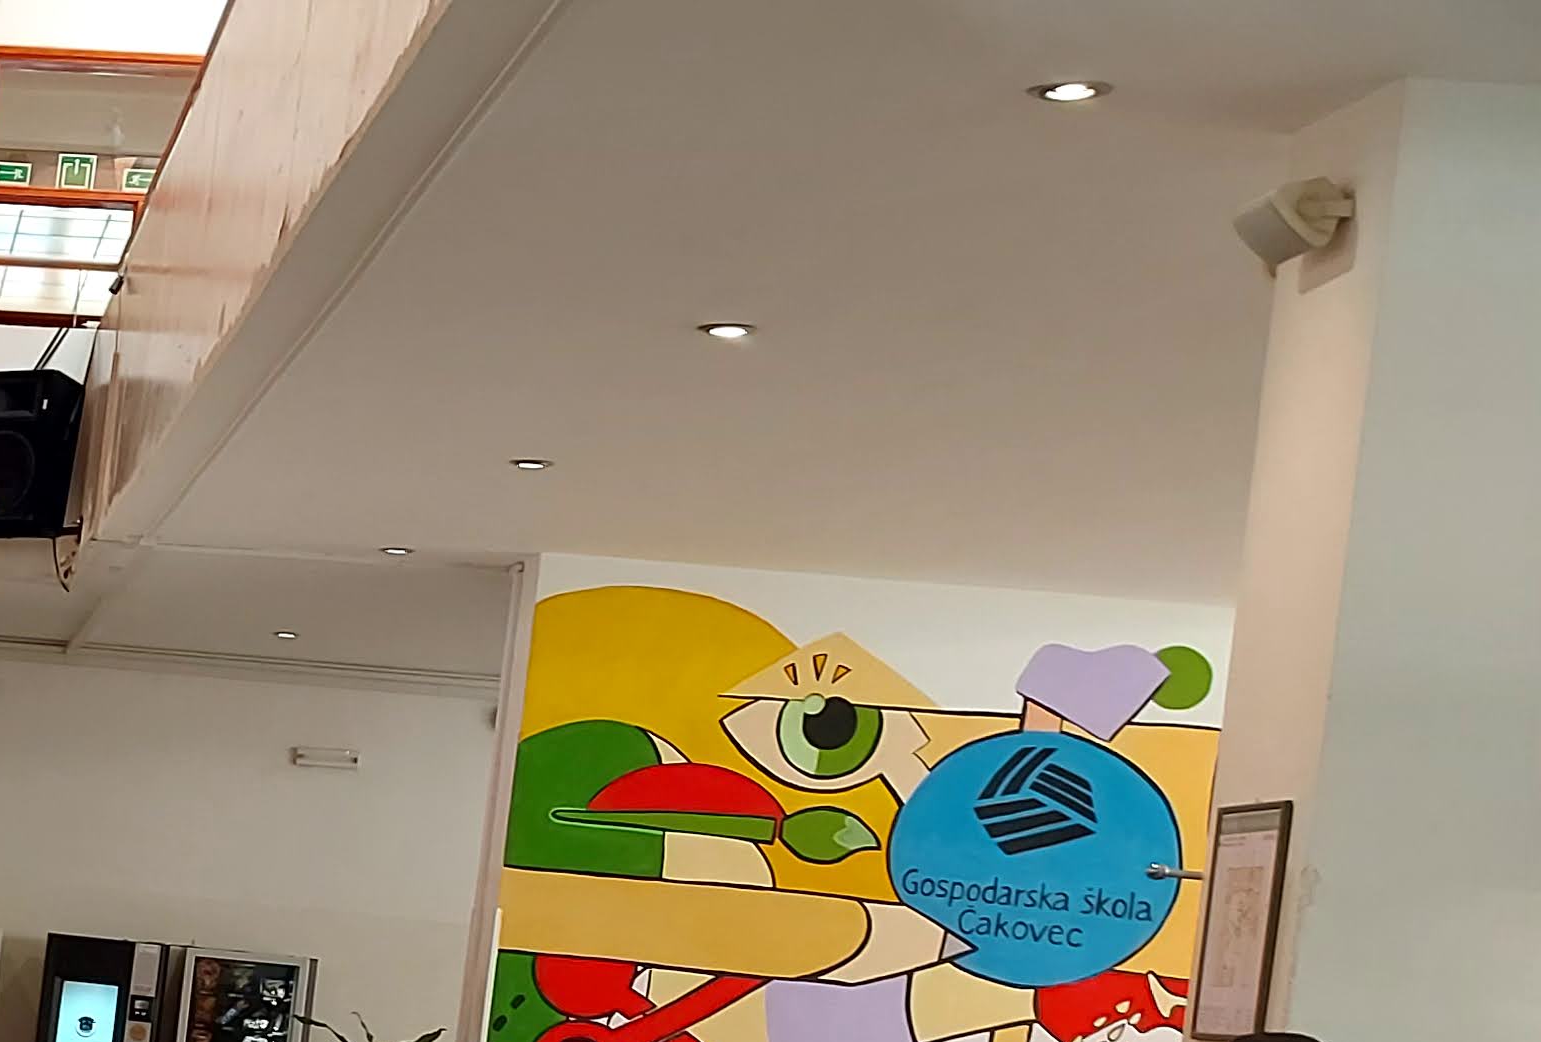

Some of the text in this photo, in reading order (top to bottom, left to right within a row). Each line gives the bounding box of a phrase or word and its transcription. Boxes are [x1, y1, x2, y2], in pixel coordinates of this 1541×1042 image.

[901, 868, 1154, 922] Gospodarska škola
[957, 905, 1084, 948] Čakovec
